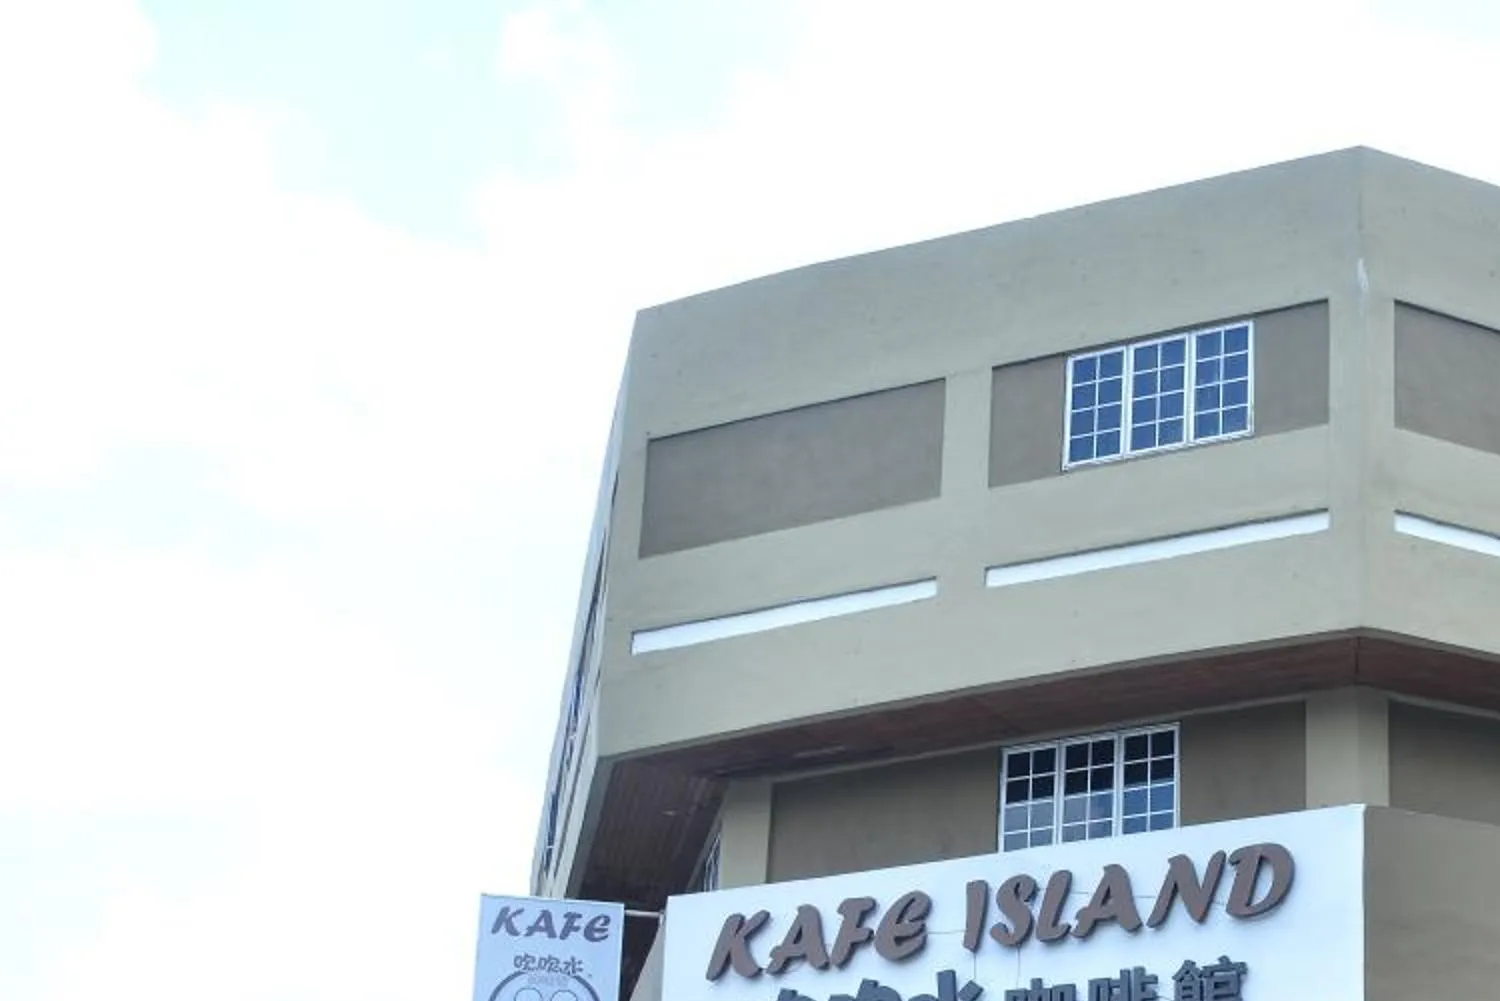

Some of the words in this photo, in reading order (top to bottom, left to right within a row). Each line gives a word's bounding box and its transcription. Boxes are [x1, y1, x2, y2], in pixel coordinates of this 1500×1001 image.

[491, 905, 612, 942] KAFE
[703, 889, 933, 982] KAFE
[962, 842, 1296, 954] ISLAND
